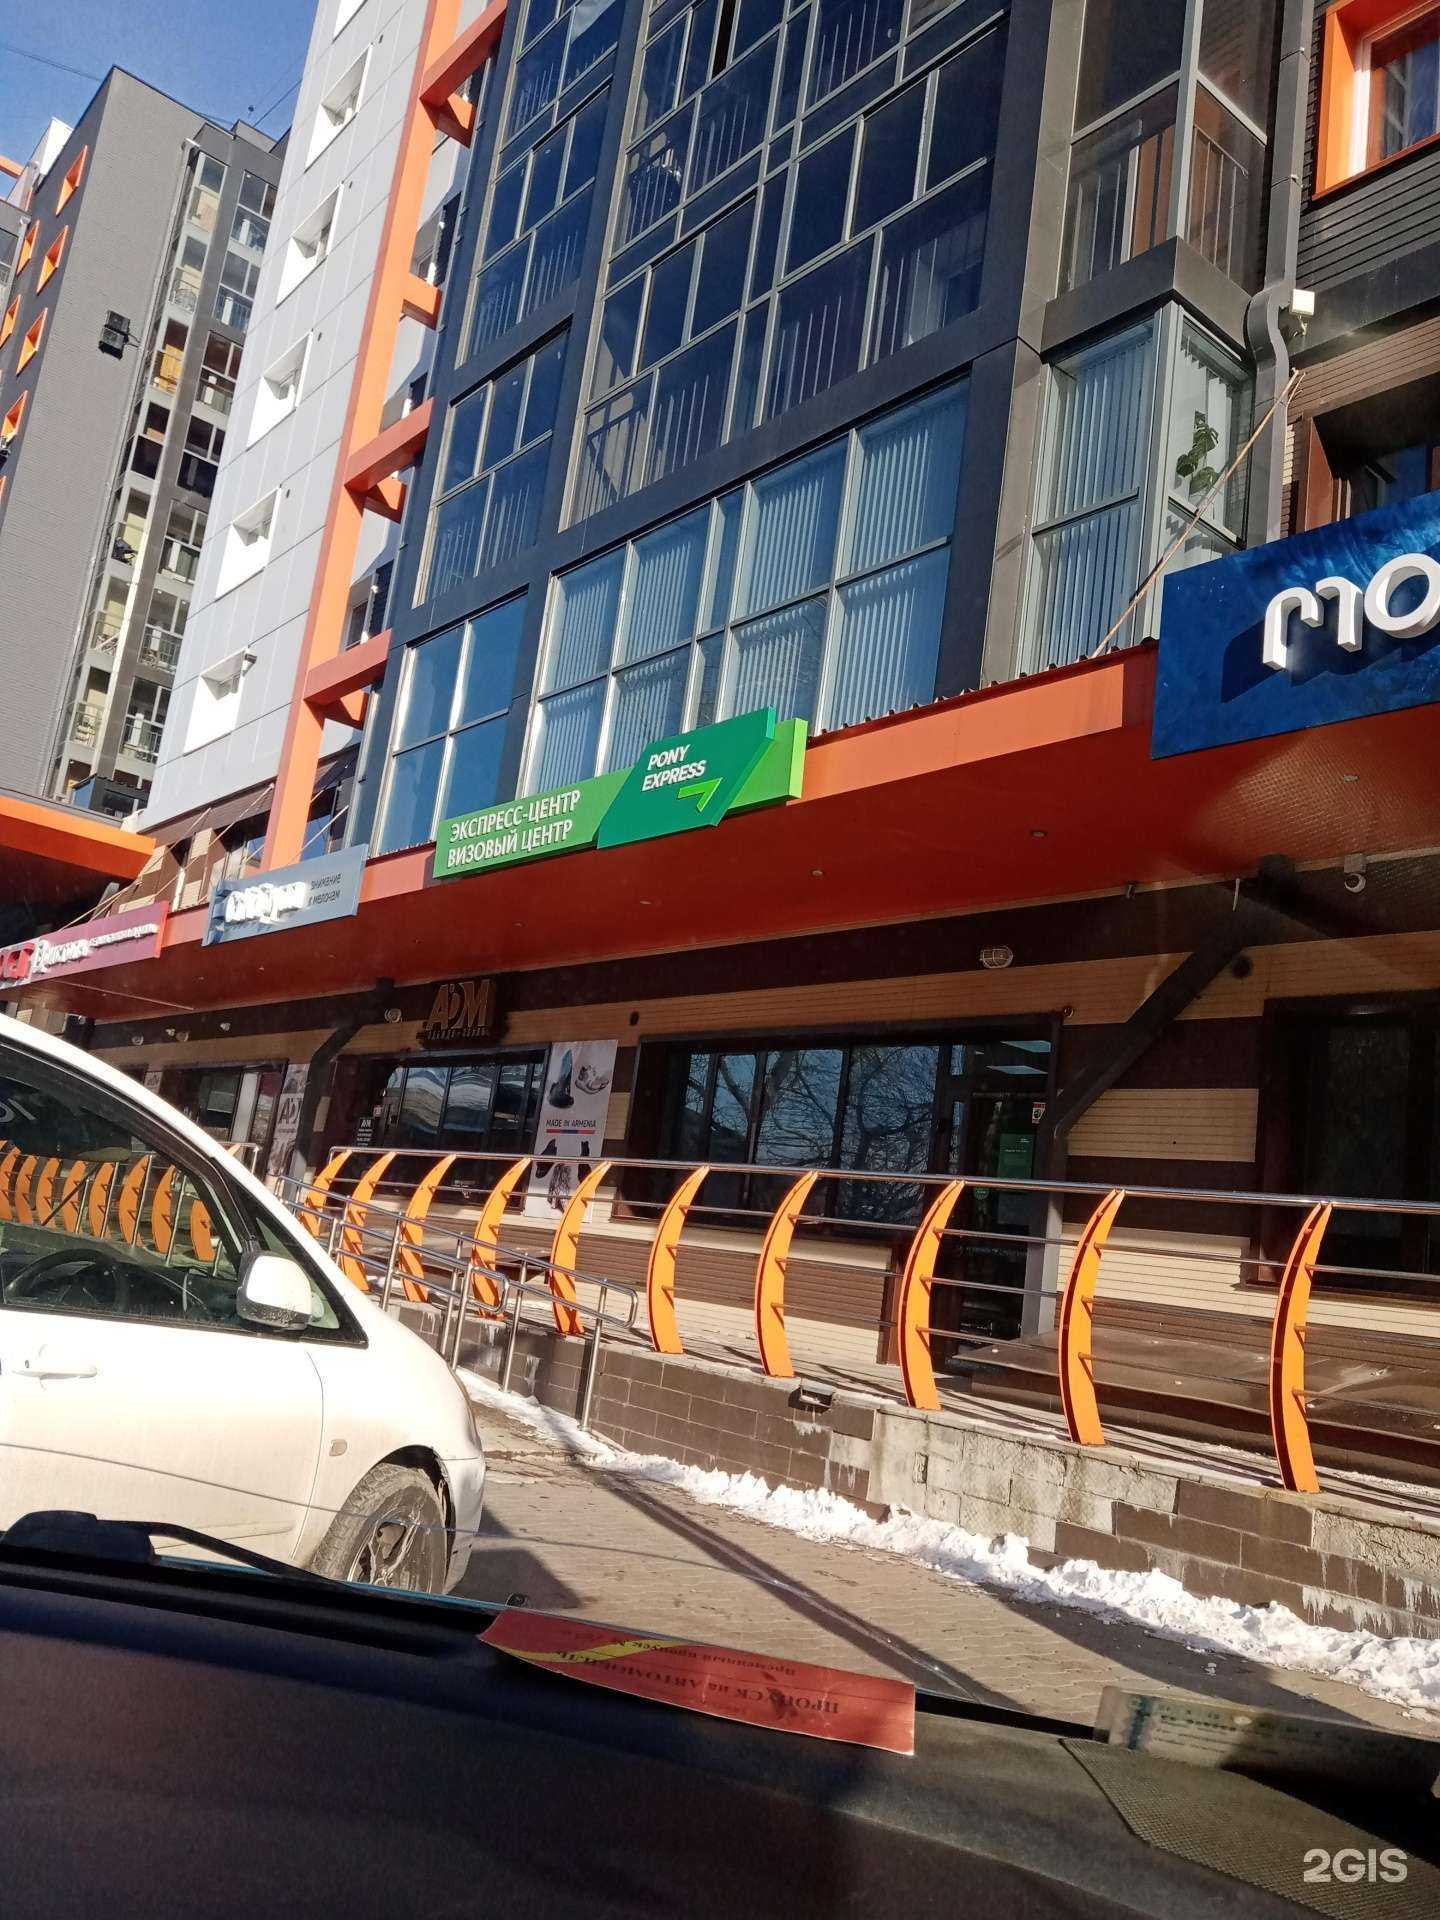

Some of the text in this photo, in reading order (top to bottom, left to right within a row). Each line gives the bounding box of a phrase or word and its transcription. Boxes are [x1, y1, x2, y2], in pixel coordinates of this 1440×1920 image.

[647, 743, 691, 771] PONY
[641, 759, 706, 792] EXPRESS
[449, 790, 580, 842] ЭКСПРЕСС-ЦЕНТР
[447, 819, 573, 868] ВИЗОВЫЙ ЦЕНТР
[546, 1119, 596, 1128] MADE IN ARMENIA
